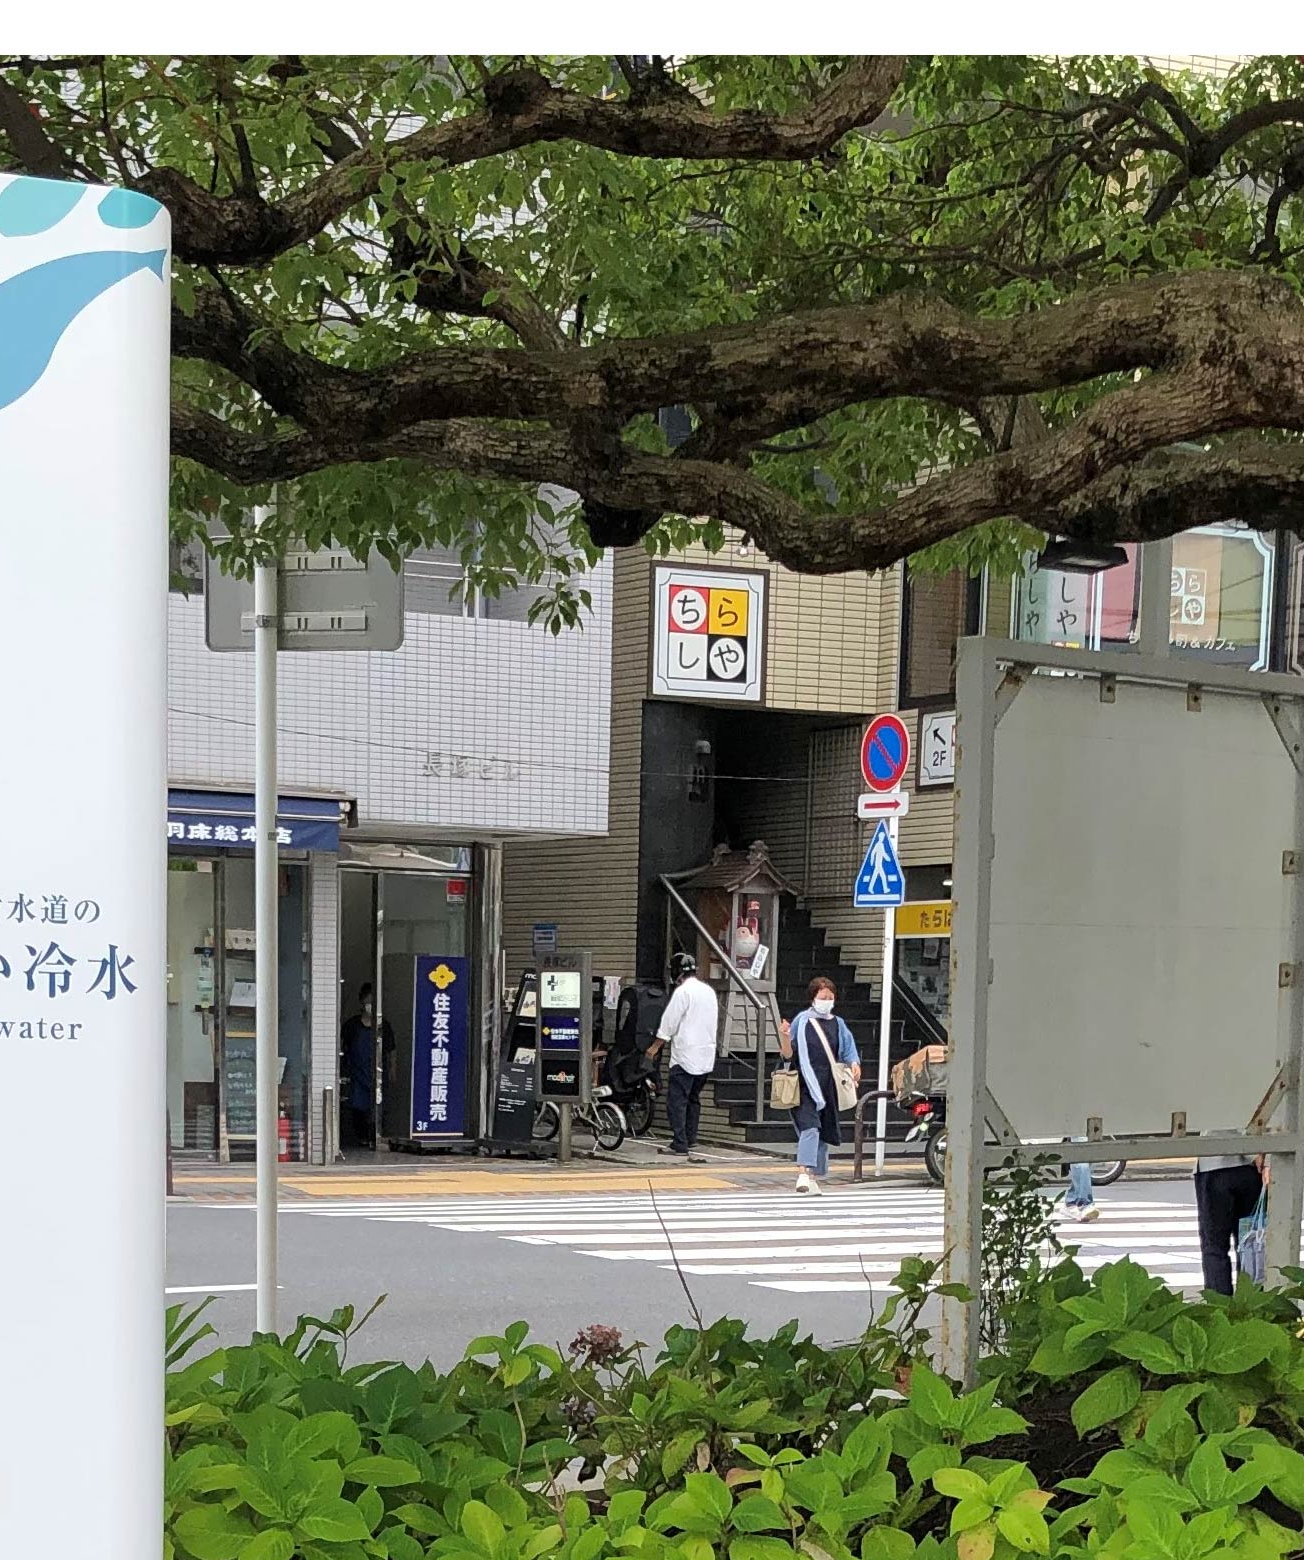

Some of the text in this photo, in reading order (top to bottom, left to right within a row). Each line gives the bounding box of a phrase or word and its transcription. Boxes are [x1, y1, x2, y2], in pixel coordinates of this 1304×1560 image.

[676, 594, 739, 628] ちら
[678, 641, 740, 674] しや
[932, 750, 947, 767] 2F
[428, 993, 451, 1122] 住友不動産販売
[416, 1120, 429, 1131] 3F
